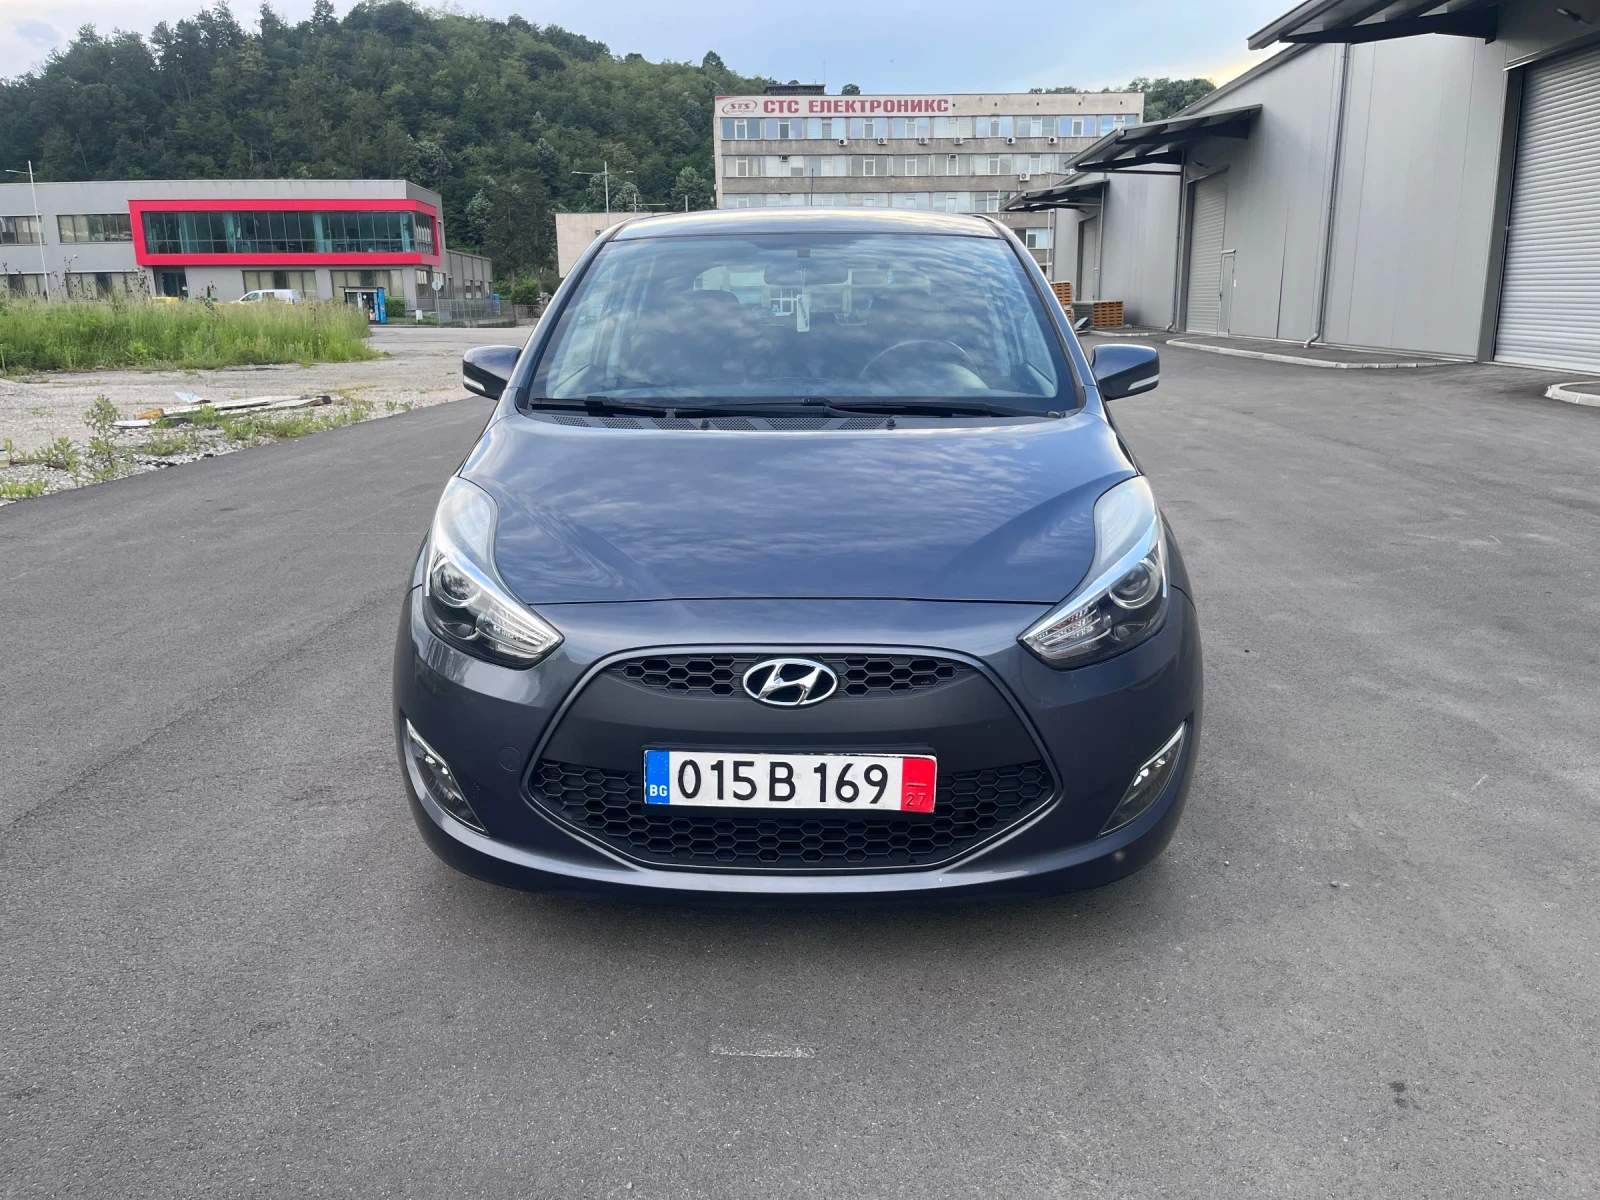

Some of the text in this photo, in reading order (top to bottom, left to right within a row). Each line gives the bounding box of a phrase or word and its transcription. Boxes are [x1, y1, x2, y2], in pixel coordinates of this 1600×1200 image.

[763, 99, 949, 113] СТС ЕЛЕКТРОНИКС
[813, 762, 889, 804] 169
[649, 784, 668, 797] BG
[906, 792, 926, 807] 27
